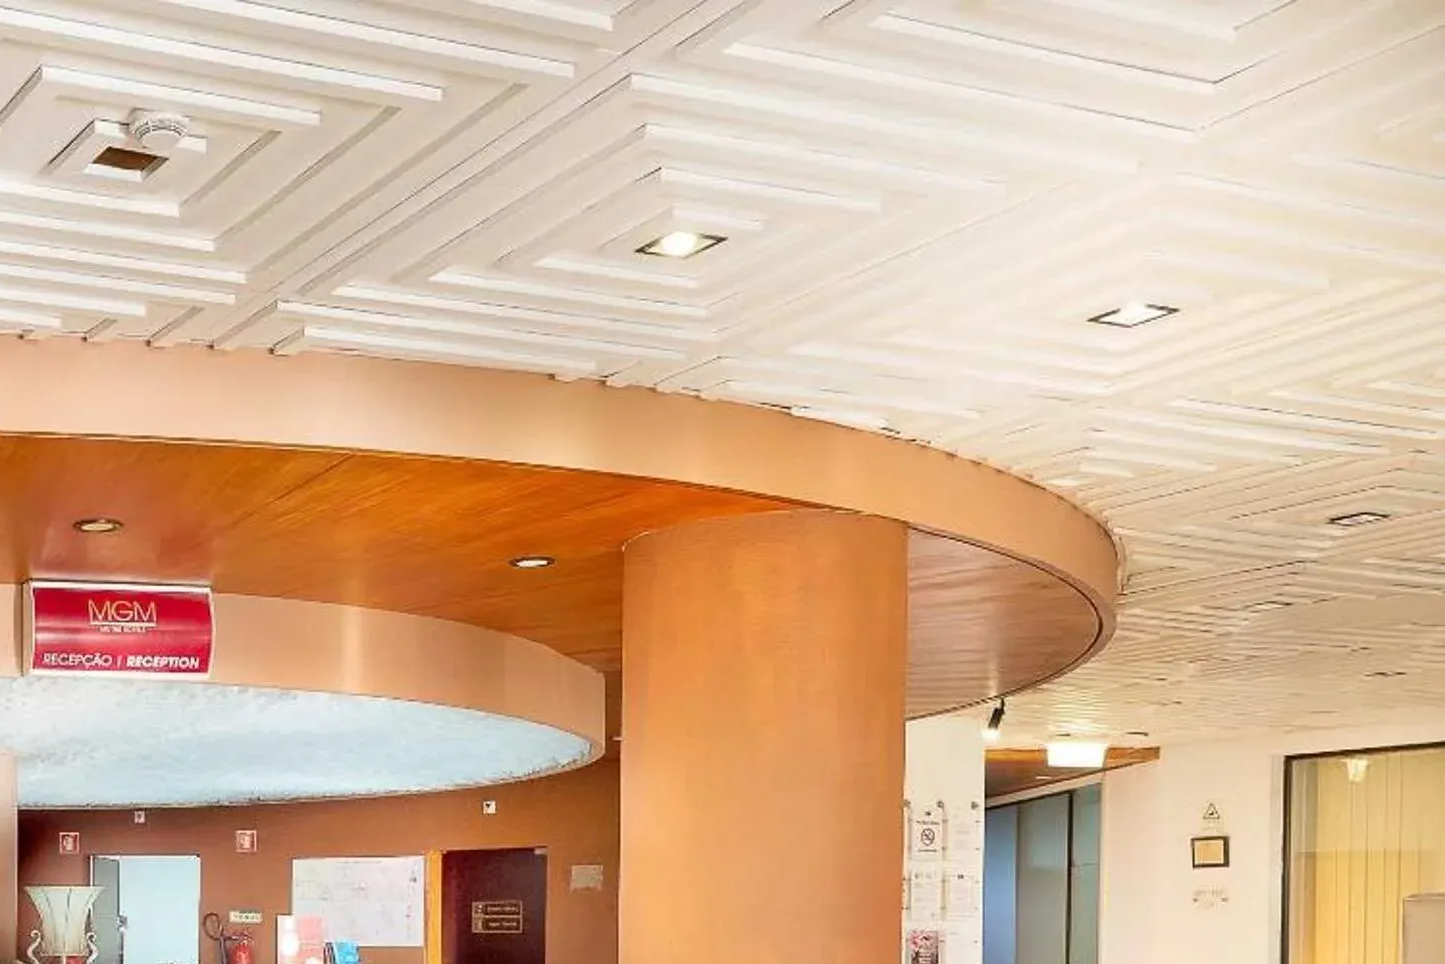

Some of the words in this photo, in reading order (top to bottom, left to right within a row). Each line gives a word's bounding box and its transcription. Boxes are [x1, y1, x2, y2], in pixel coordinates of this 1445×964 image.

[88, 599, 157, 622] MGM
[42, 653, 111, 668] RECEPÇÃO
[126, 655, 199, 668] RECEPTION
